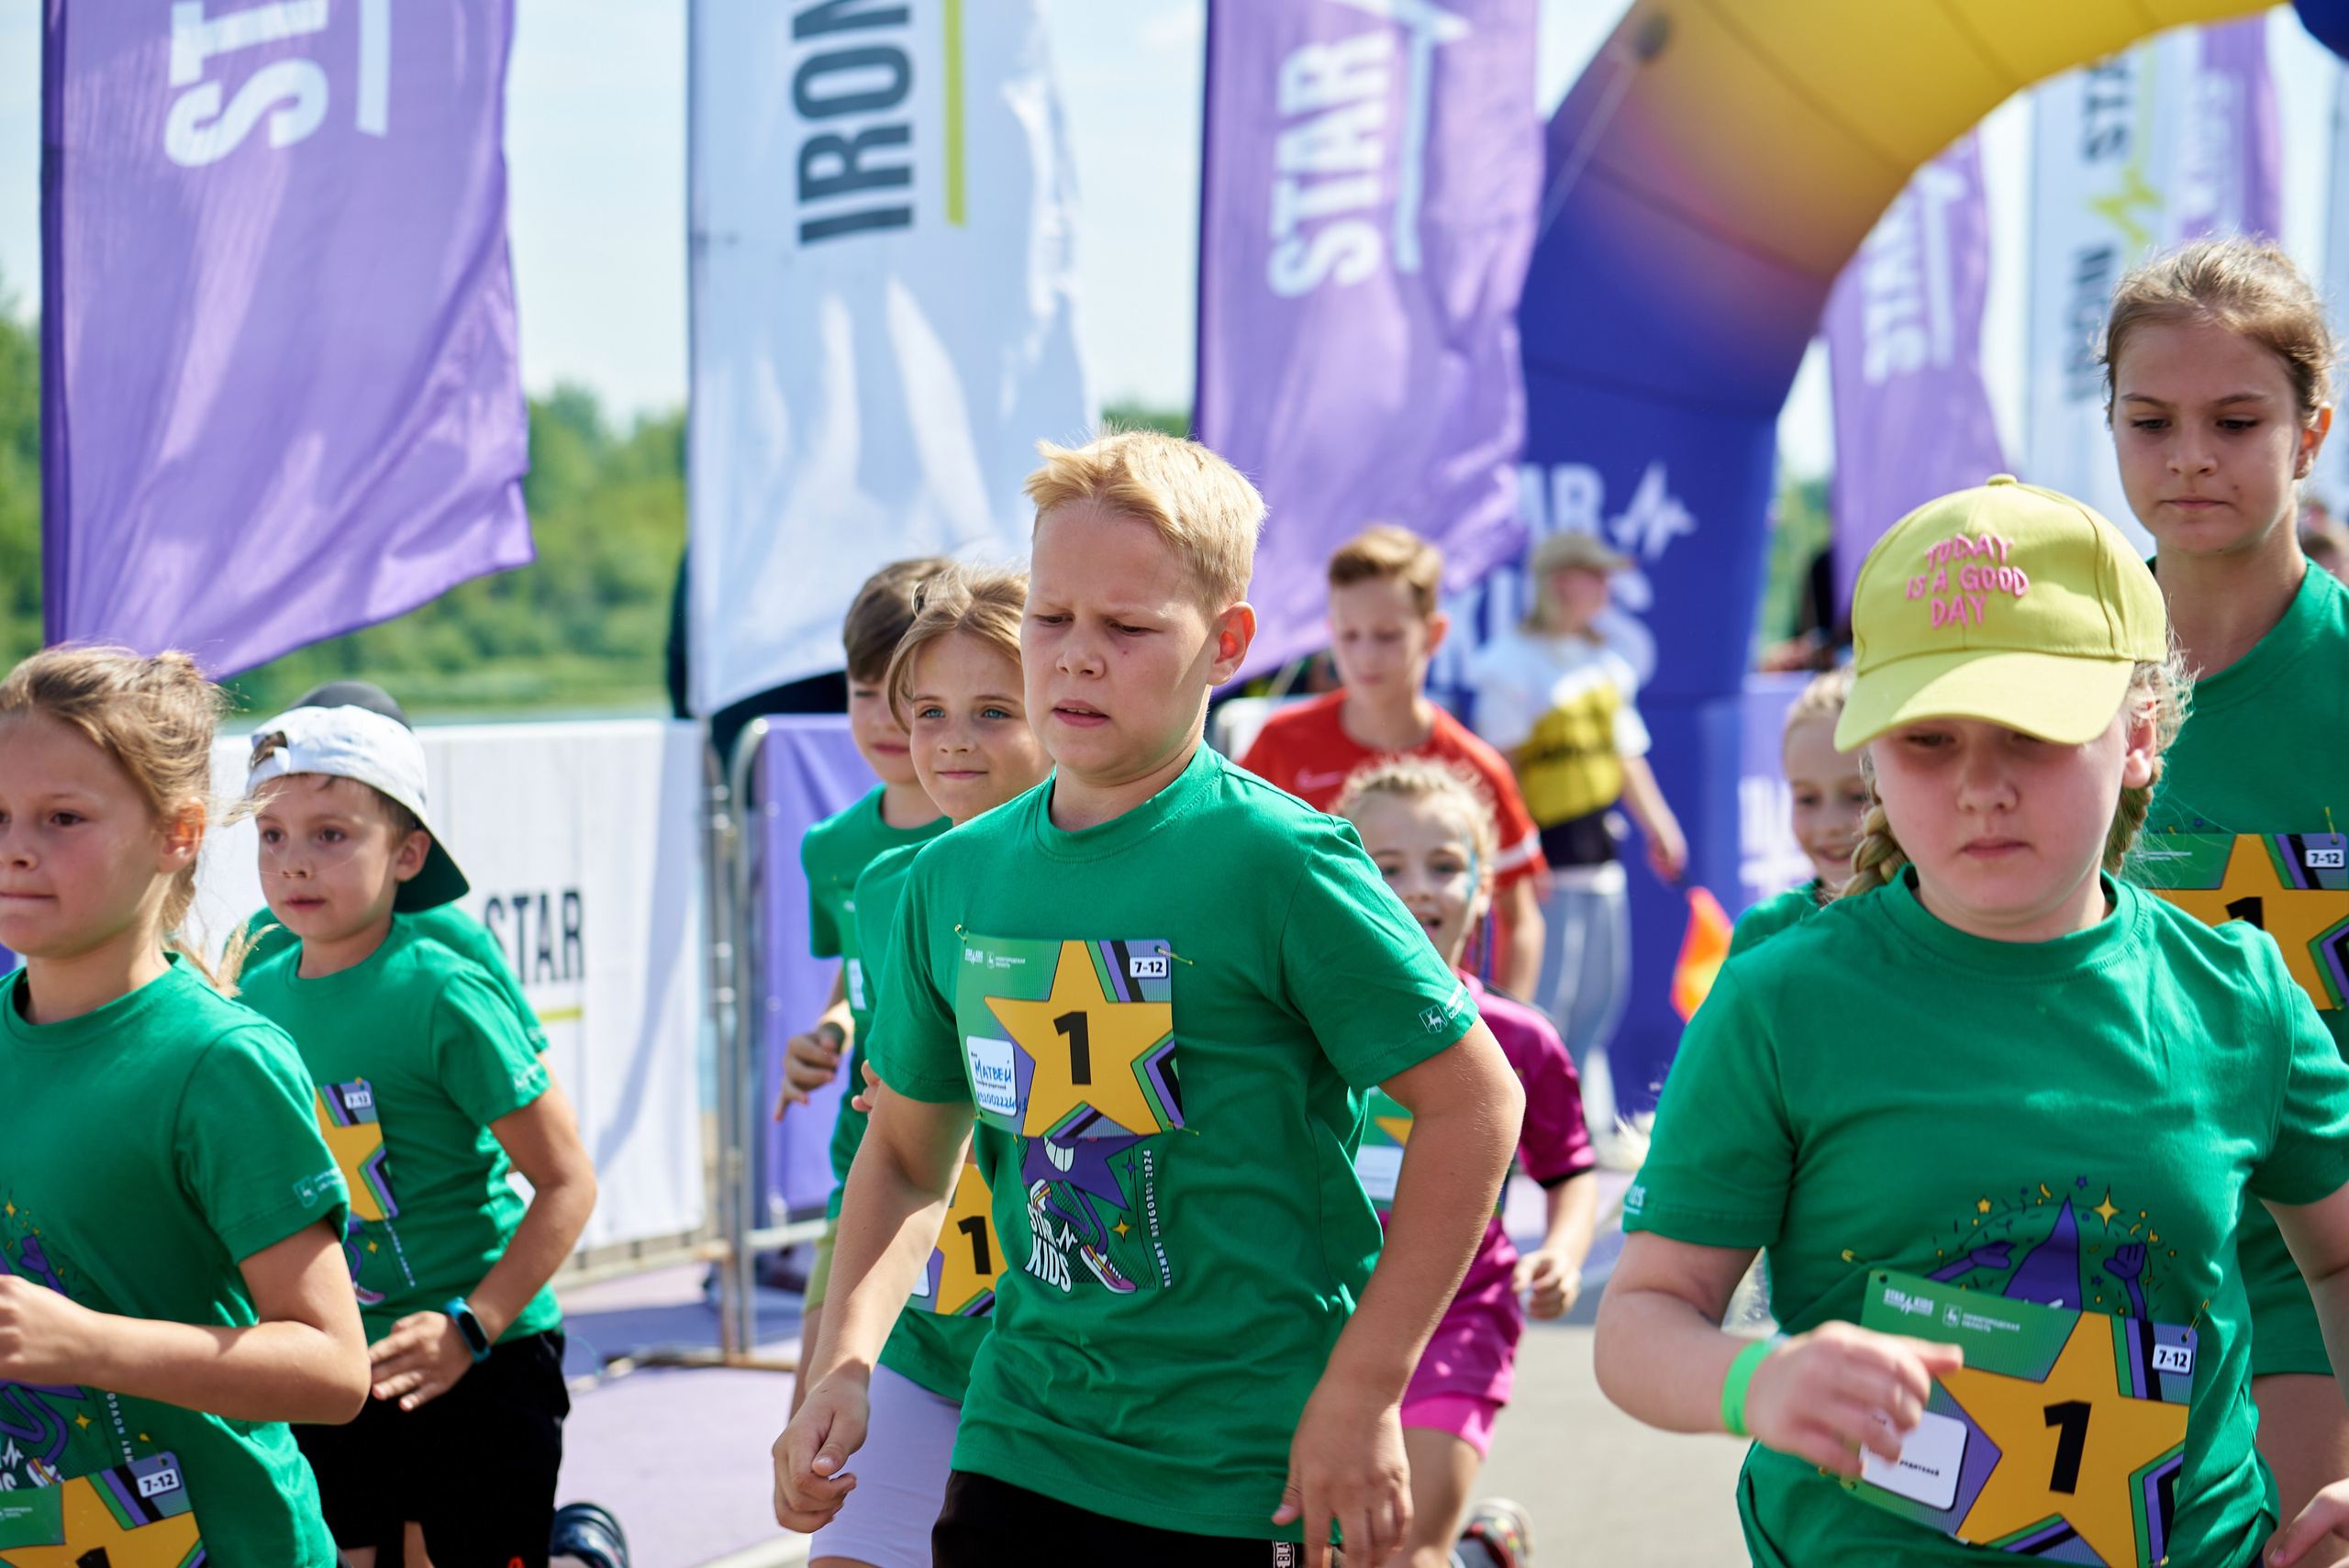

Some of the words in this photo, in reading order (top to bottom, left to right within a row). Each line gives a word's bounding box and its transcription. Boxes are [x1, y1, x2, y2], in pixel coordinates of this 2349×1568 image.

[1266, 28, 1395, 297] STAR
[1924, 533, 2014, 572] TODAY
[1906, 574, 1928, 600] IS
[1932, 568, 1948, 594] A
[1959, 564, 2030, 597] GOOD
[1931, 594, 1987, 629] DAY
[2311, 852, 2341, 865] 7-12
[1134, 962, 1163, 973] 7-12
[1053, 1011, 1092, 1085] 1
[1142, 1150, 1153, 1178] 2024
[1628, 1184, 1646, 1207] IDS
[957, 1216, 992, 1274] 1
[1024, 1233, 1072, 1293] KIDS
[2158, 1349, 2188, 1368] 7-12
[2043, 1399, 2092, 1496] 1
[143, 1473, 175, 1493] 7-12
